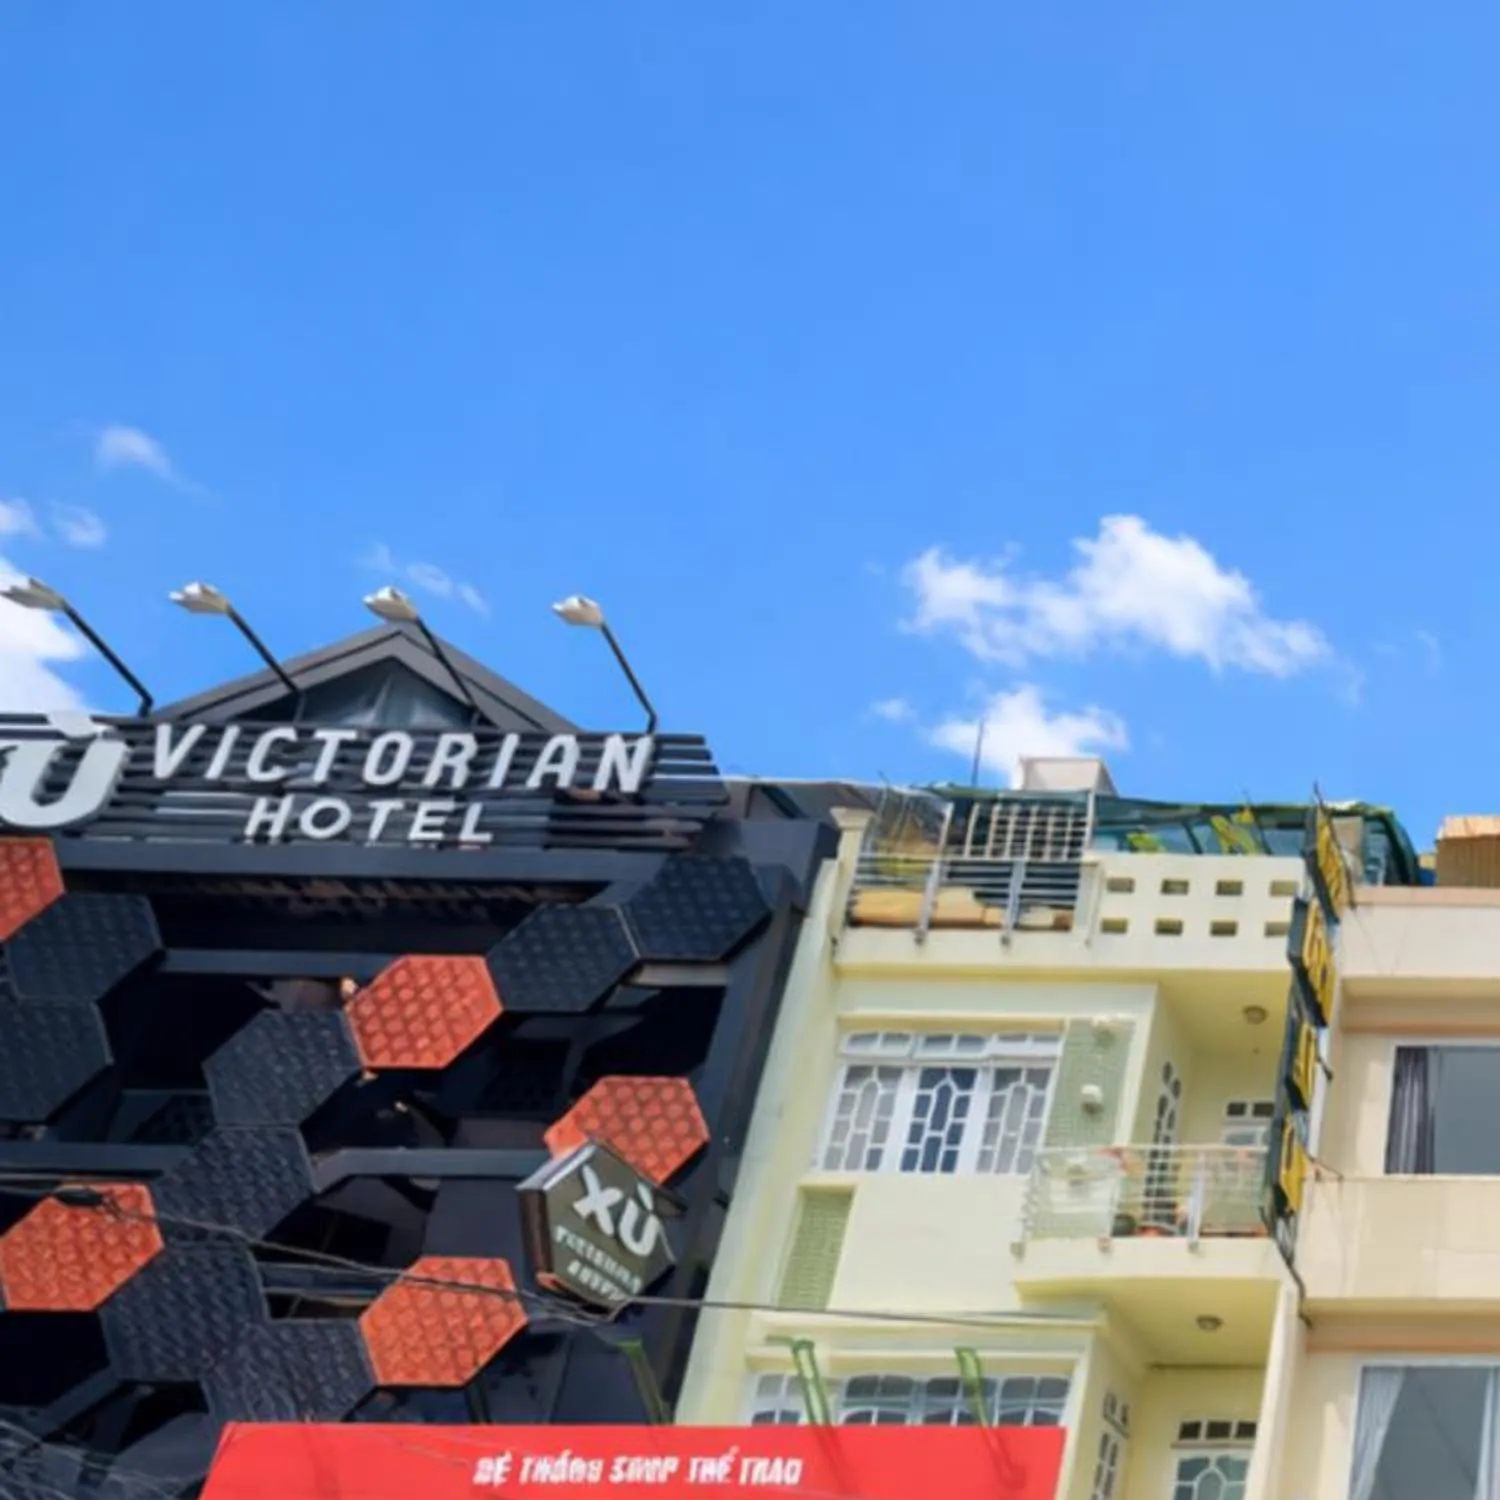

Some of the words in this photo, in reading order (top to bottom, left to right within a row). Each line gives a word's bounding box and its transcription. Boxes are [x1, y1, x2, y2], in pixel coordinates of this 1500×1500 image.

[153, 722, 654, 793] VICTORIAN
[244, 794, 495, 843] HOTEL
[572, 1164, 662, 1257] XÙ
